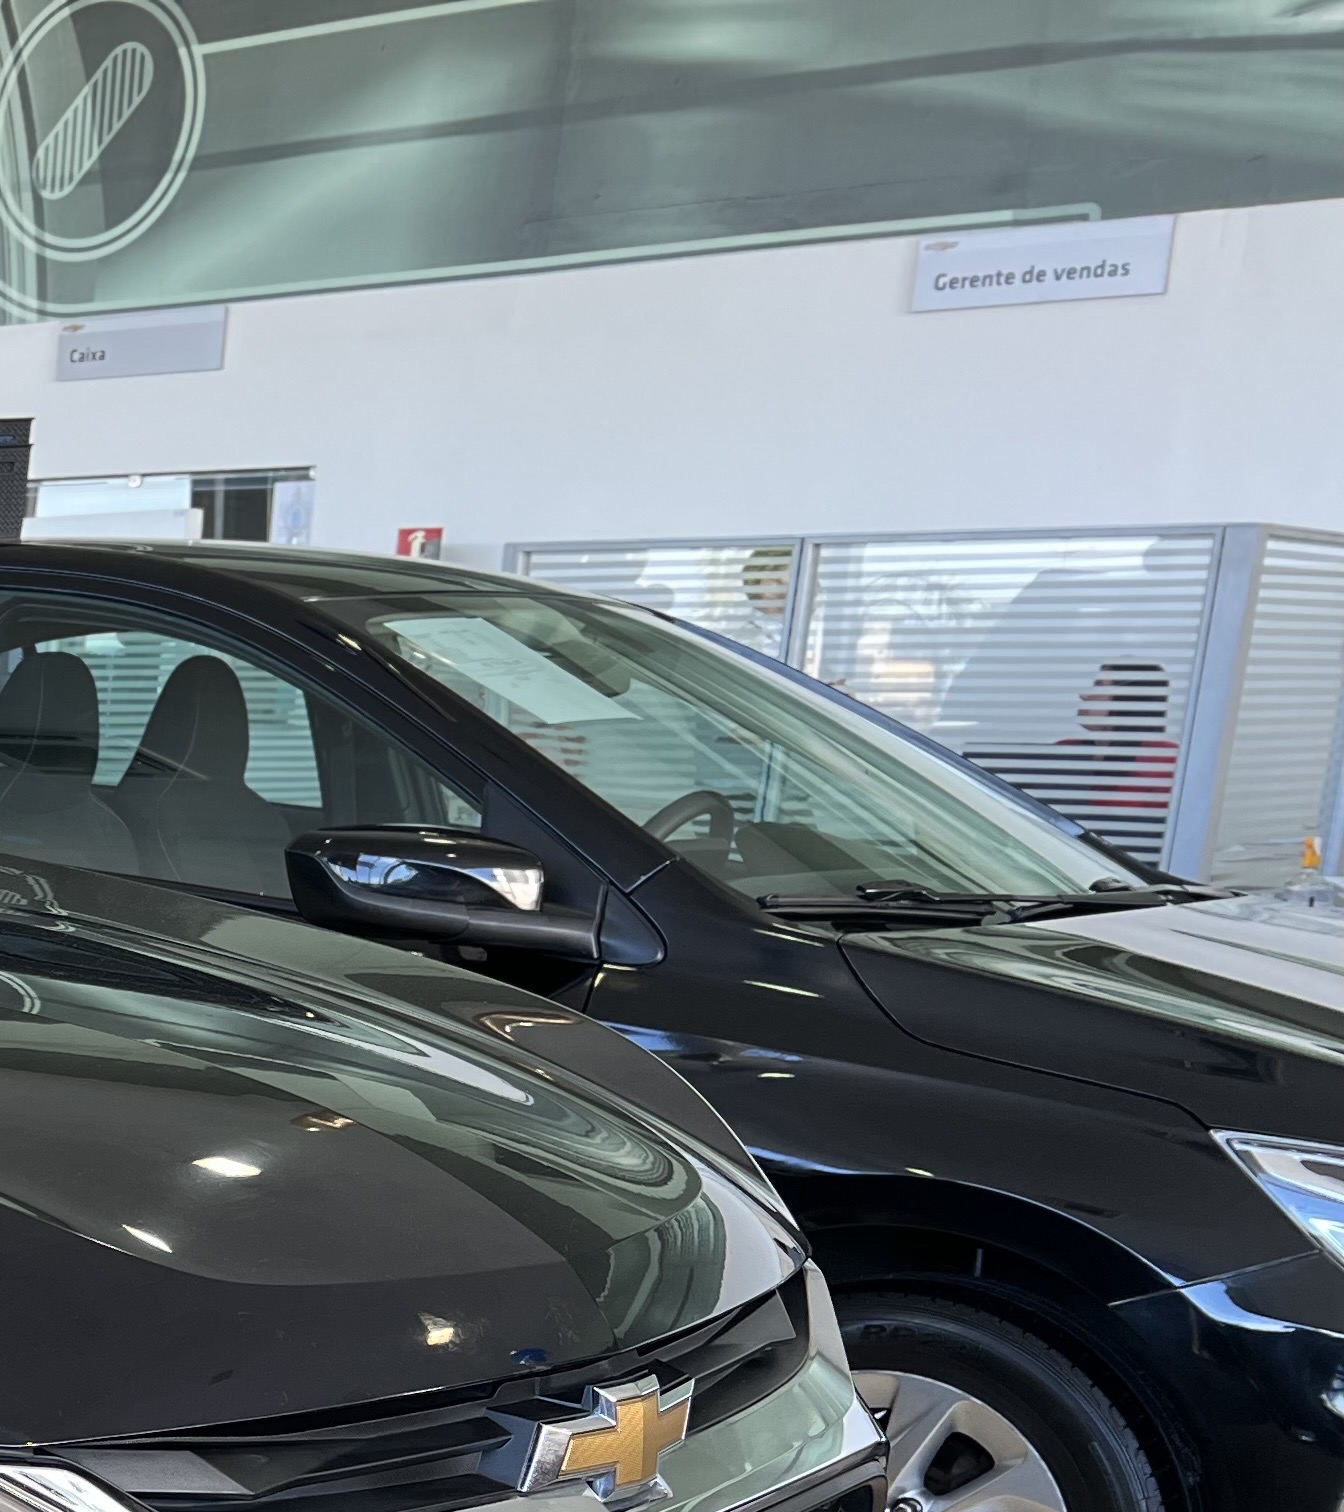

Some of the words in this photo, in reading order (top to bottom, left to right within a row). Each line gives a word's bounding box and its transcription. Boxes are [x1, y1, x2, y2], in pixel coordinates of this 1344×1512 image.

[934, 269, 1016, 292] Gerente
[1022, 265, 1047, 284] de
[1053, 260, 1131, 282] vendas
[70, 347, 106, 363] Caixa
